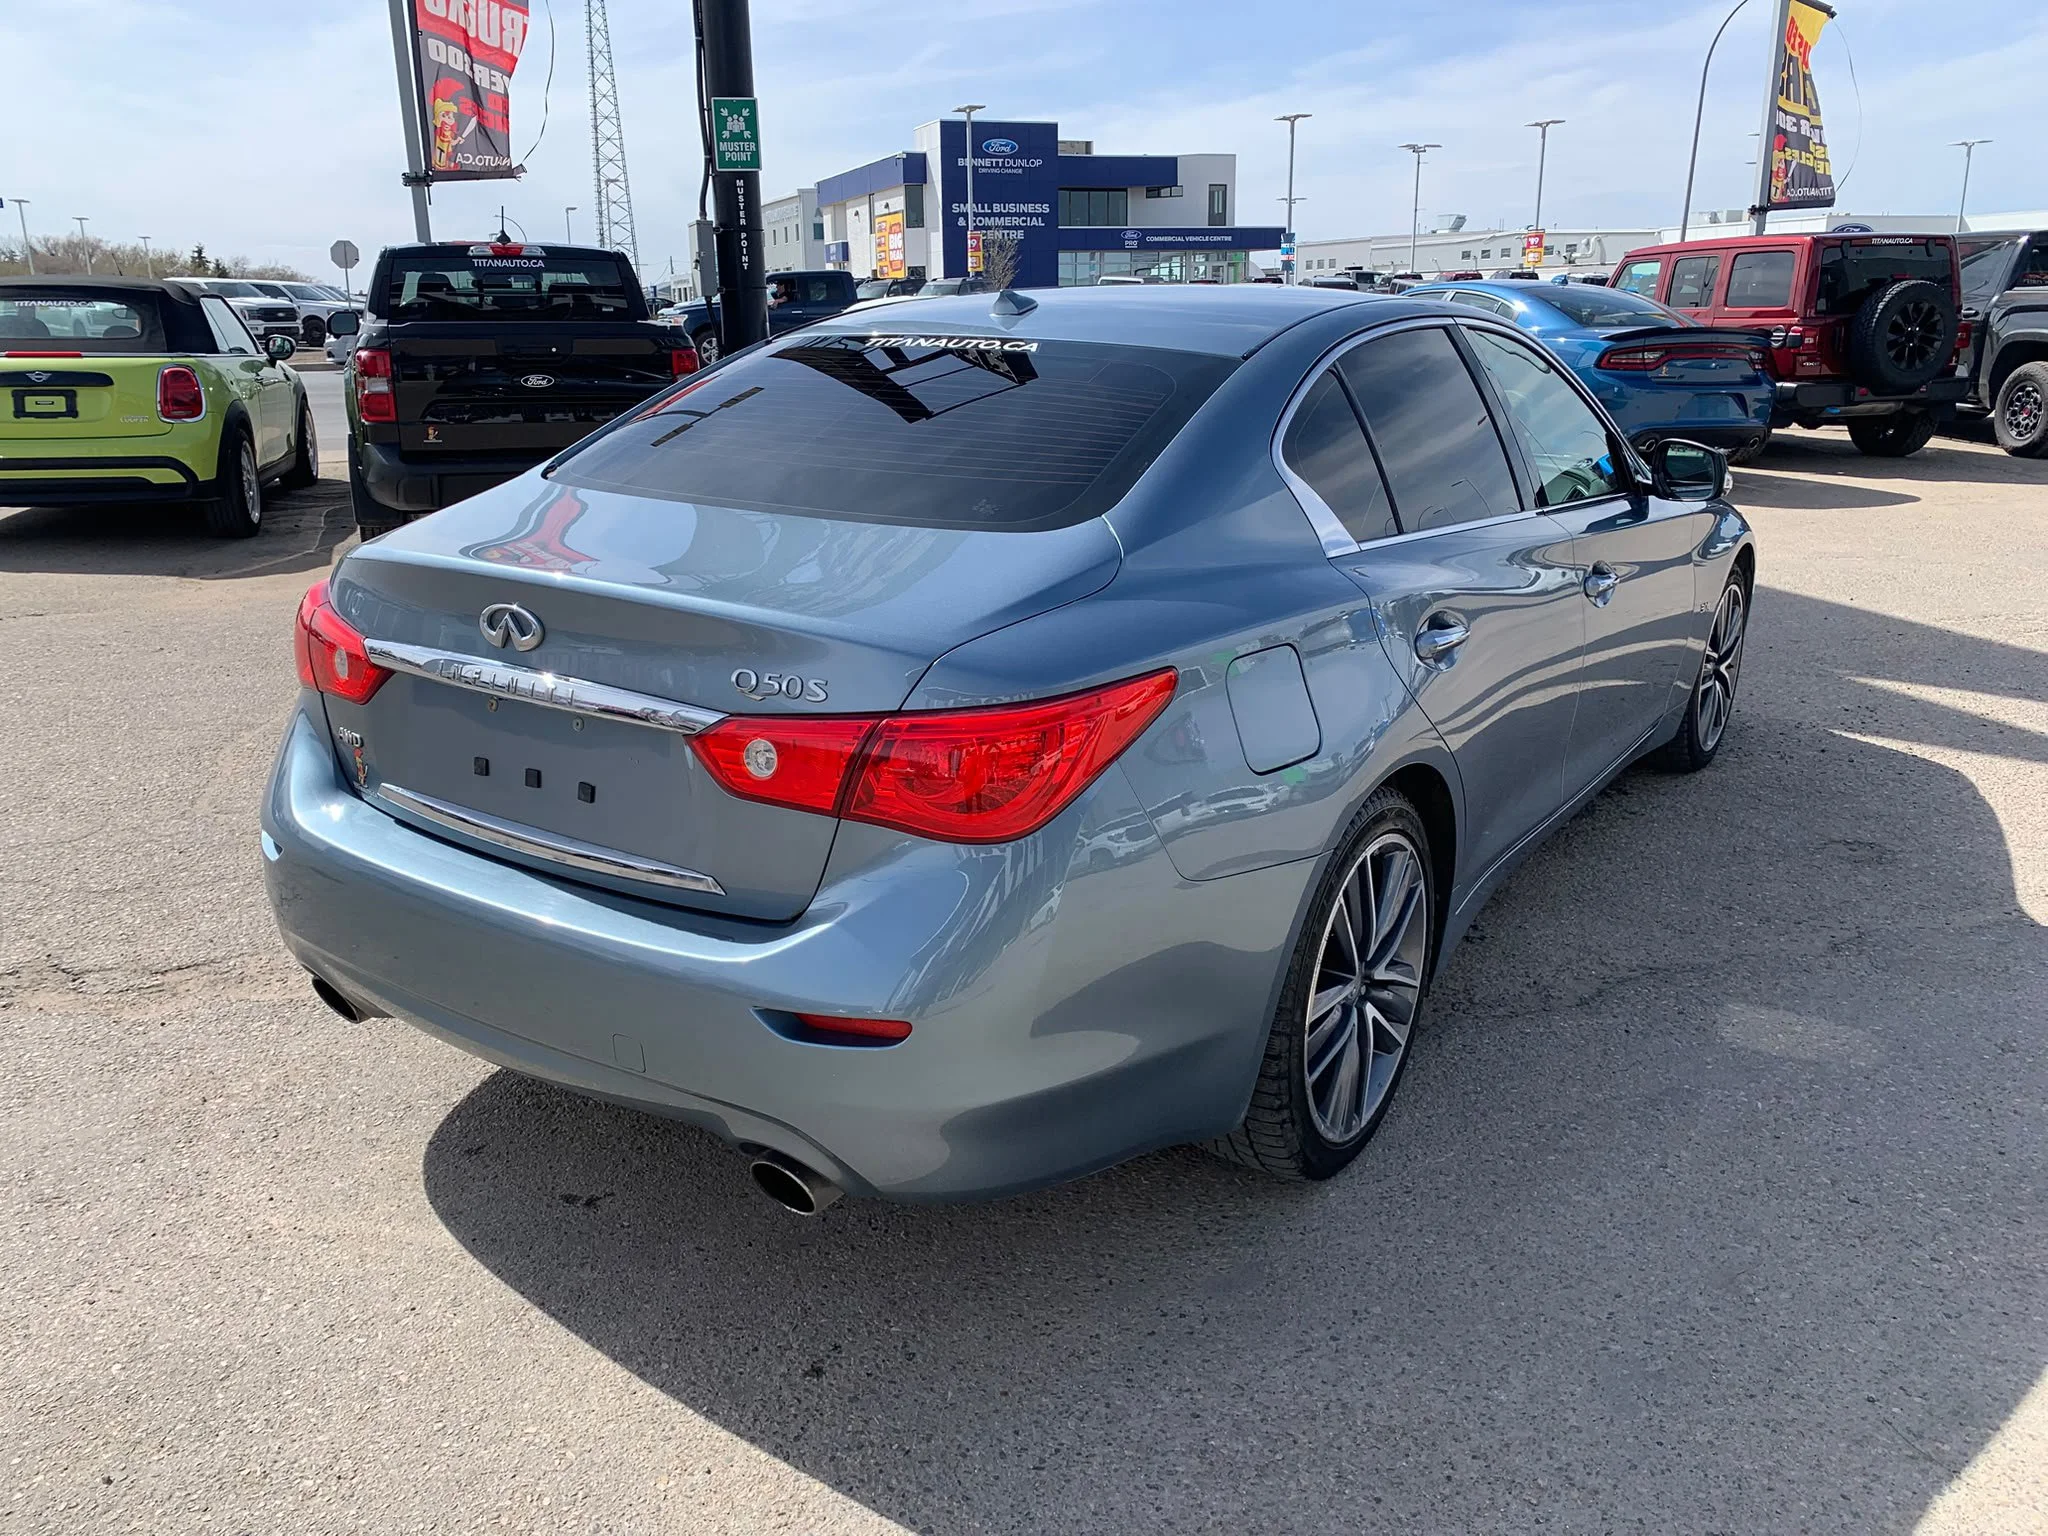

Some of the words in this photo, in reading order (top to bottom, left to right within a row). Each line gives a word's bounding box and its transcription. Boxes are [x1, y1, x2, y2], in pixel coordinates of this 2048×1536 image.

[719, 141, 756, 152] MUSTER
[725, 151, 752, 162] POINT
[957, 157, 1003, 168] BNNETT
[1004, 158, 1043, 168] DUNLOP
[1000, 167, 1023, 175] CHANGE
[736, 179, 746, 226] MUSTER
[952, 203, 991, 213] SMALL
[992, 203, 1050, 213] BUSINESS
[957, 217, 967, 227] &
[980, 229, 1025, 240] CENTRE
[1871, 237, 1913, 245] TITANAUTO.CA
[740, 232, 749, 270] POINT
[472, 258, 546, 268] TITANAUTO.CA
[864, 337, 1039, 353] TITANAUTO.CA
[438, 659, 575, 707] INFINITI
[730, 668, 829, 703] Q50S
[339, 726, 364, 748] AWD
